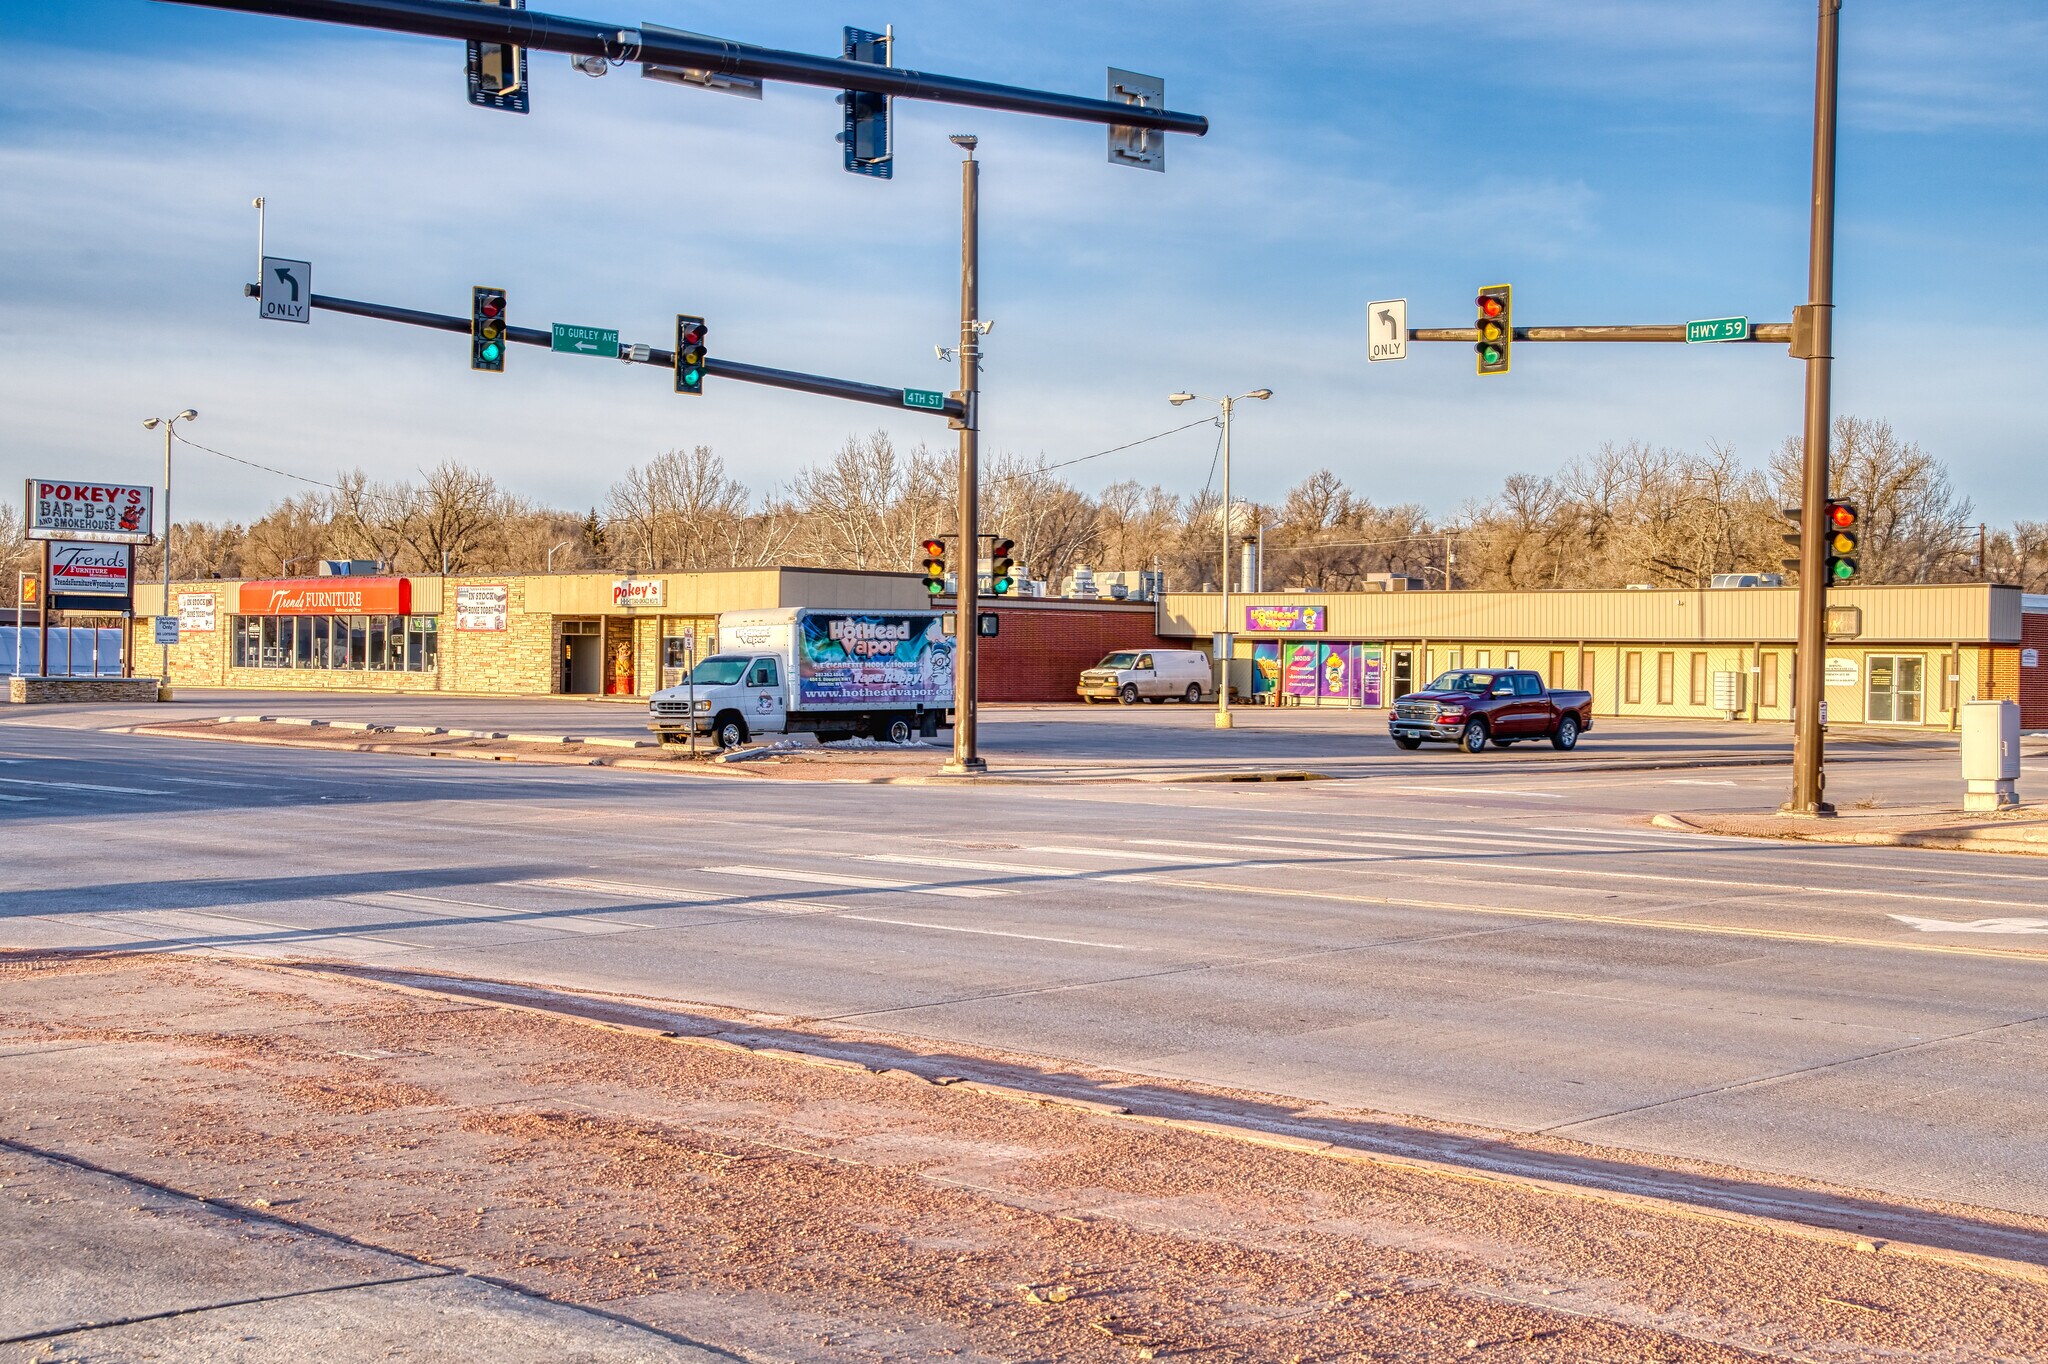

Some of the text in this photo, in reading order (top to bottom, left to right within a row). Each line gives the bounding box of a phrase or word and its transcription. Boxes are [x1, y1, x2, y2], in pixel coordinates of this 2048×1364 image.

[268, 302, 303, 317] ONLY
[555, 326, 617, 343] TO GURLEY AVE
[1691, 322, 1742, 338] HWY 59
[1373, 343, 1401, 356] ONLY
[908, 392, 941, 405] 4TH ST
[40, 483, 142, 505] POKEY'S
[40, 500, 116, 520] BAR-B-Q
[40, 517, 116, 530] AND SMOKEHOUSE
[55, 546, 125, 576] Trends
[70, 566, 108, 575] FURNITURE
[54, 578, 126, 590] TrendsFurnitureWyoming.com
[475, 592, 494, 600] STOCK
[613, 582, 658, 604] Pokey's
[268, 589, 363, 615] Trends FURNITURE
[1250, 607, 1299, 620] HotHead
[829, 618, 910, 640] HotHead
[1256, 618, 1292, 629] Vapor
[841, 637, 899, 658] Vapor
